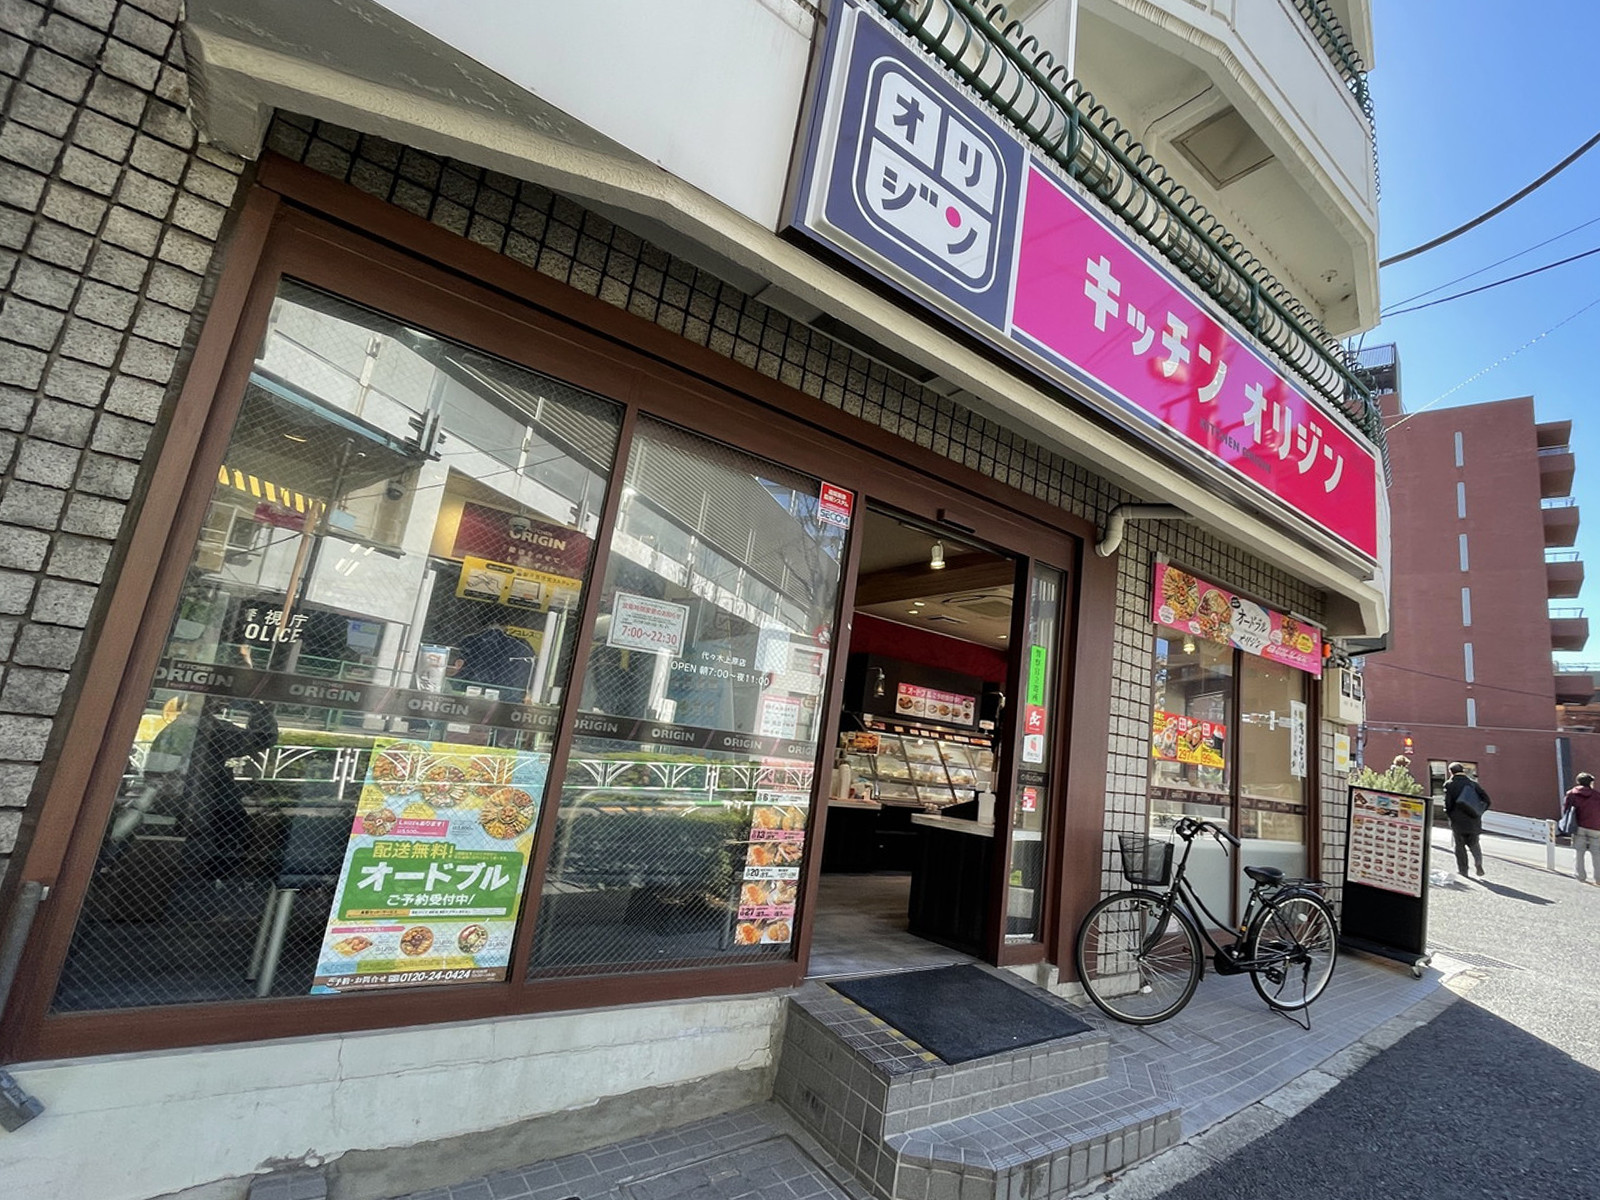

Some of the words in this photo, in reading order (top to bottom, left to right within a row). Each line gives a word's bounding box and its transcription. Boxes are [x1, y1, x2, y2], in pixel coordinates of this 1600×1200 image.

[1083, 255, 1228, 404] キッチン
[1242, 382, 1344, 494] オリジン
[1200, 418, 1240, 453] KITCHEN
[820, 509, 849, 525] SECOM
[243, 622, 303, 643] OLICE
[154, 665, 234, 688] ORIGIN
[670, 660, 697, 674] OPEN
[289, 683, 362, 703] ORIGIN
[407, 699, 470, 716] ORIGIN
[651, 727, 696, 743] ORIGIN
[723, 737, 763, 750] ORIGIN
[372, 841, 454, 860] 配送無料!
[356, 861, 510, 892] オードブル
[400, 969, 472, 983] 0120-24-0424
